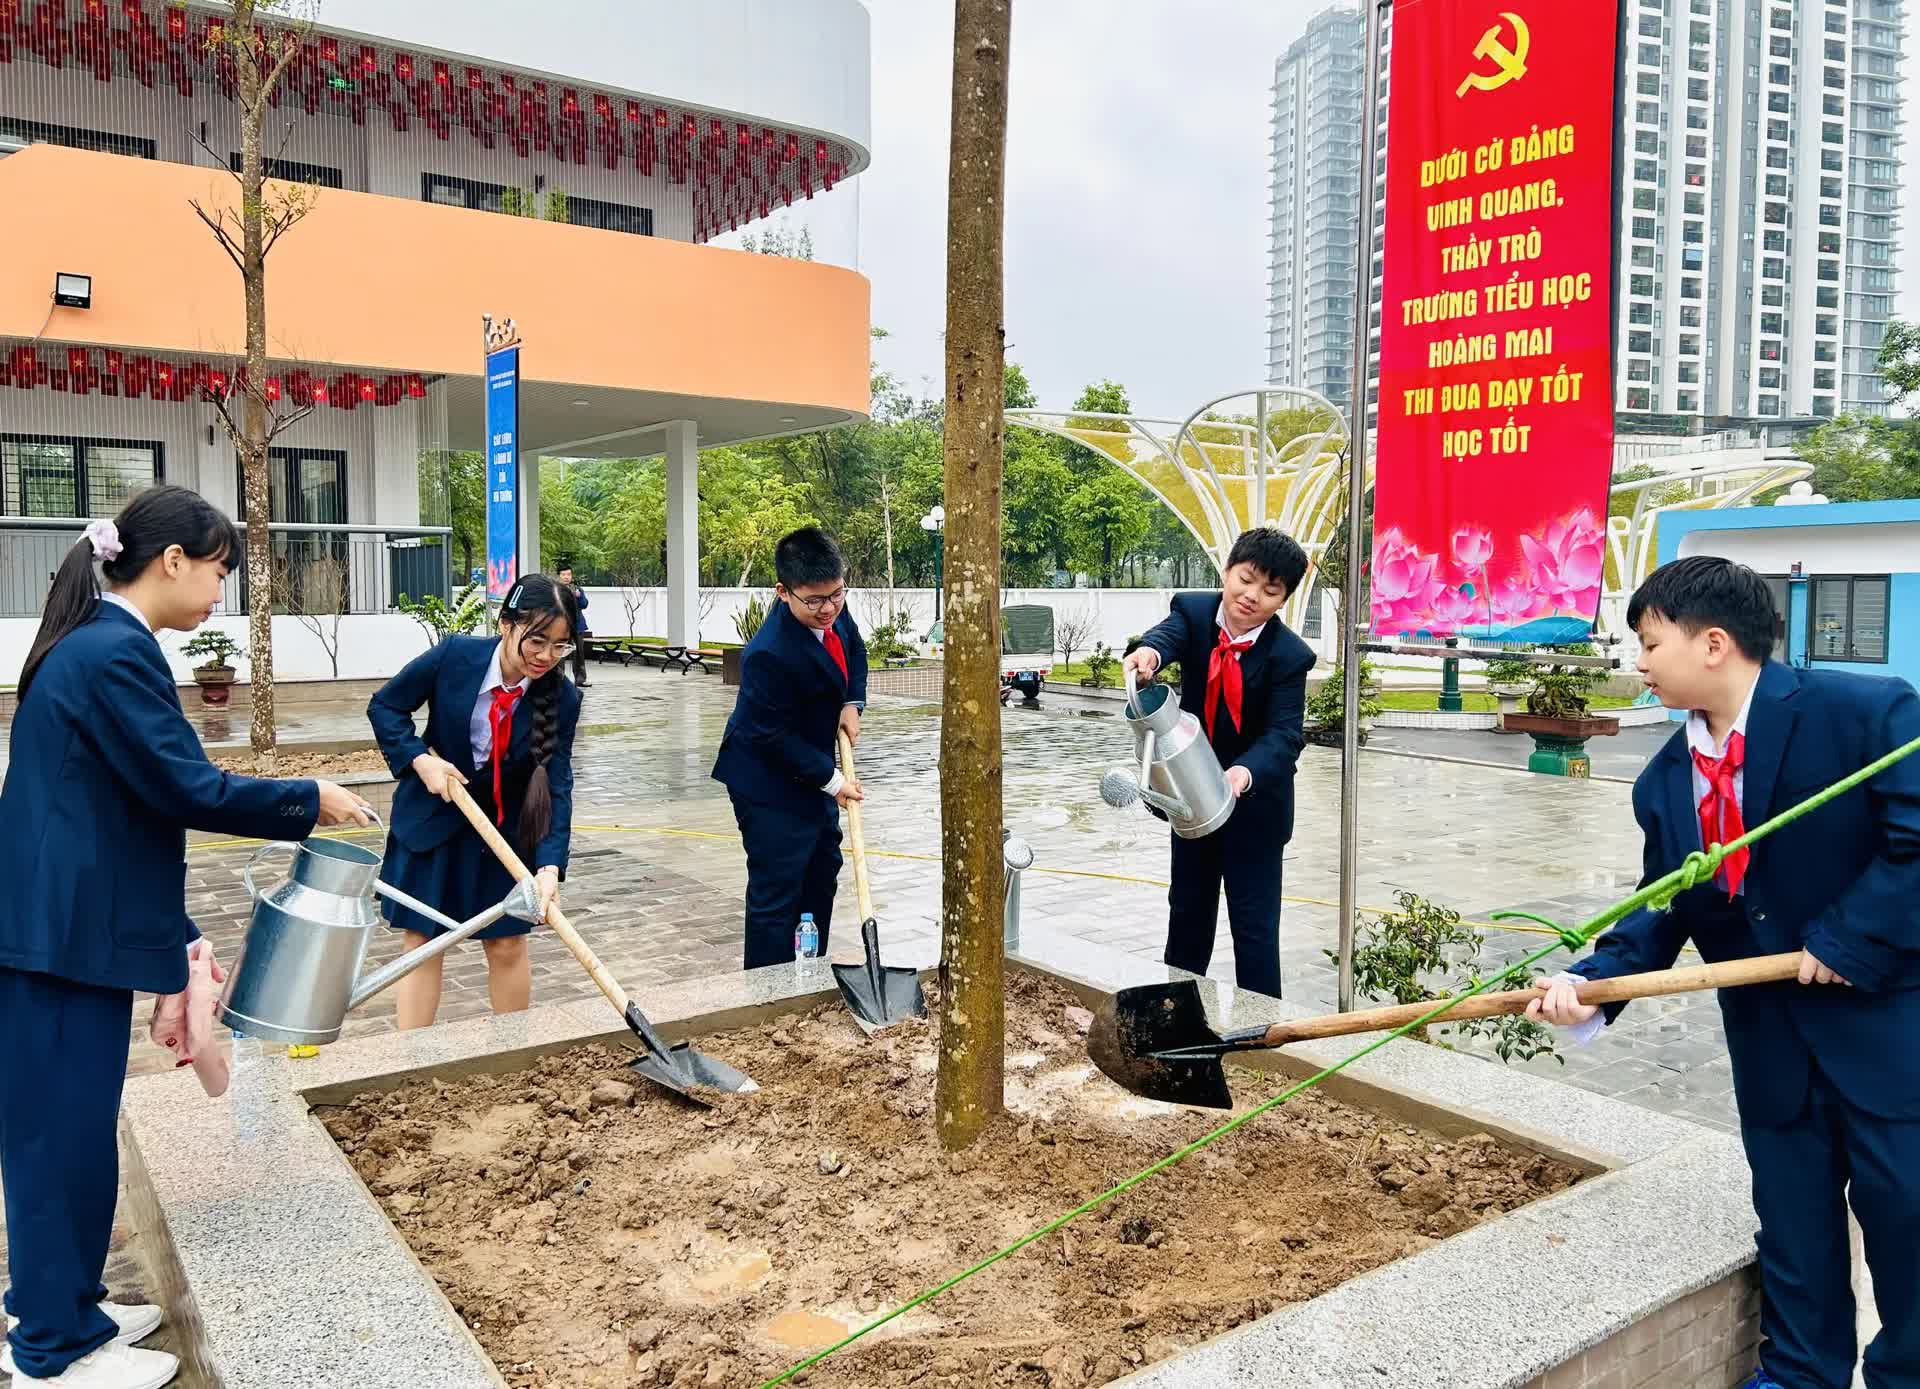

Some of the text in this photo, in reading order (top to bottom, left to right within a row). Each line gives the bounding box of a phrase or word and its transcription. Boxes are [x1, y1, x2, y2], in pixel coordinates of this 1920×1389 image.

[1420, 124, 1574, 188] DƯỚI CỜ ĐẢNG
[1479, 178, 1564, 221] QUANG,
[1441, 225, 1542, 274] THẦY TRÒ
[1401, 270, 1592, 326] TRƯỜNG TIỂU HỌC
[1428, 326, 1553, 369] HOÀNG MAI
[1403, 363, 1584, 416] THI ĐUA DẠY TỐT
[1442, 416, 1532, 463] HỌC TỐT
